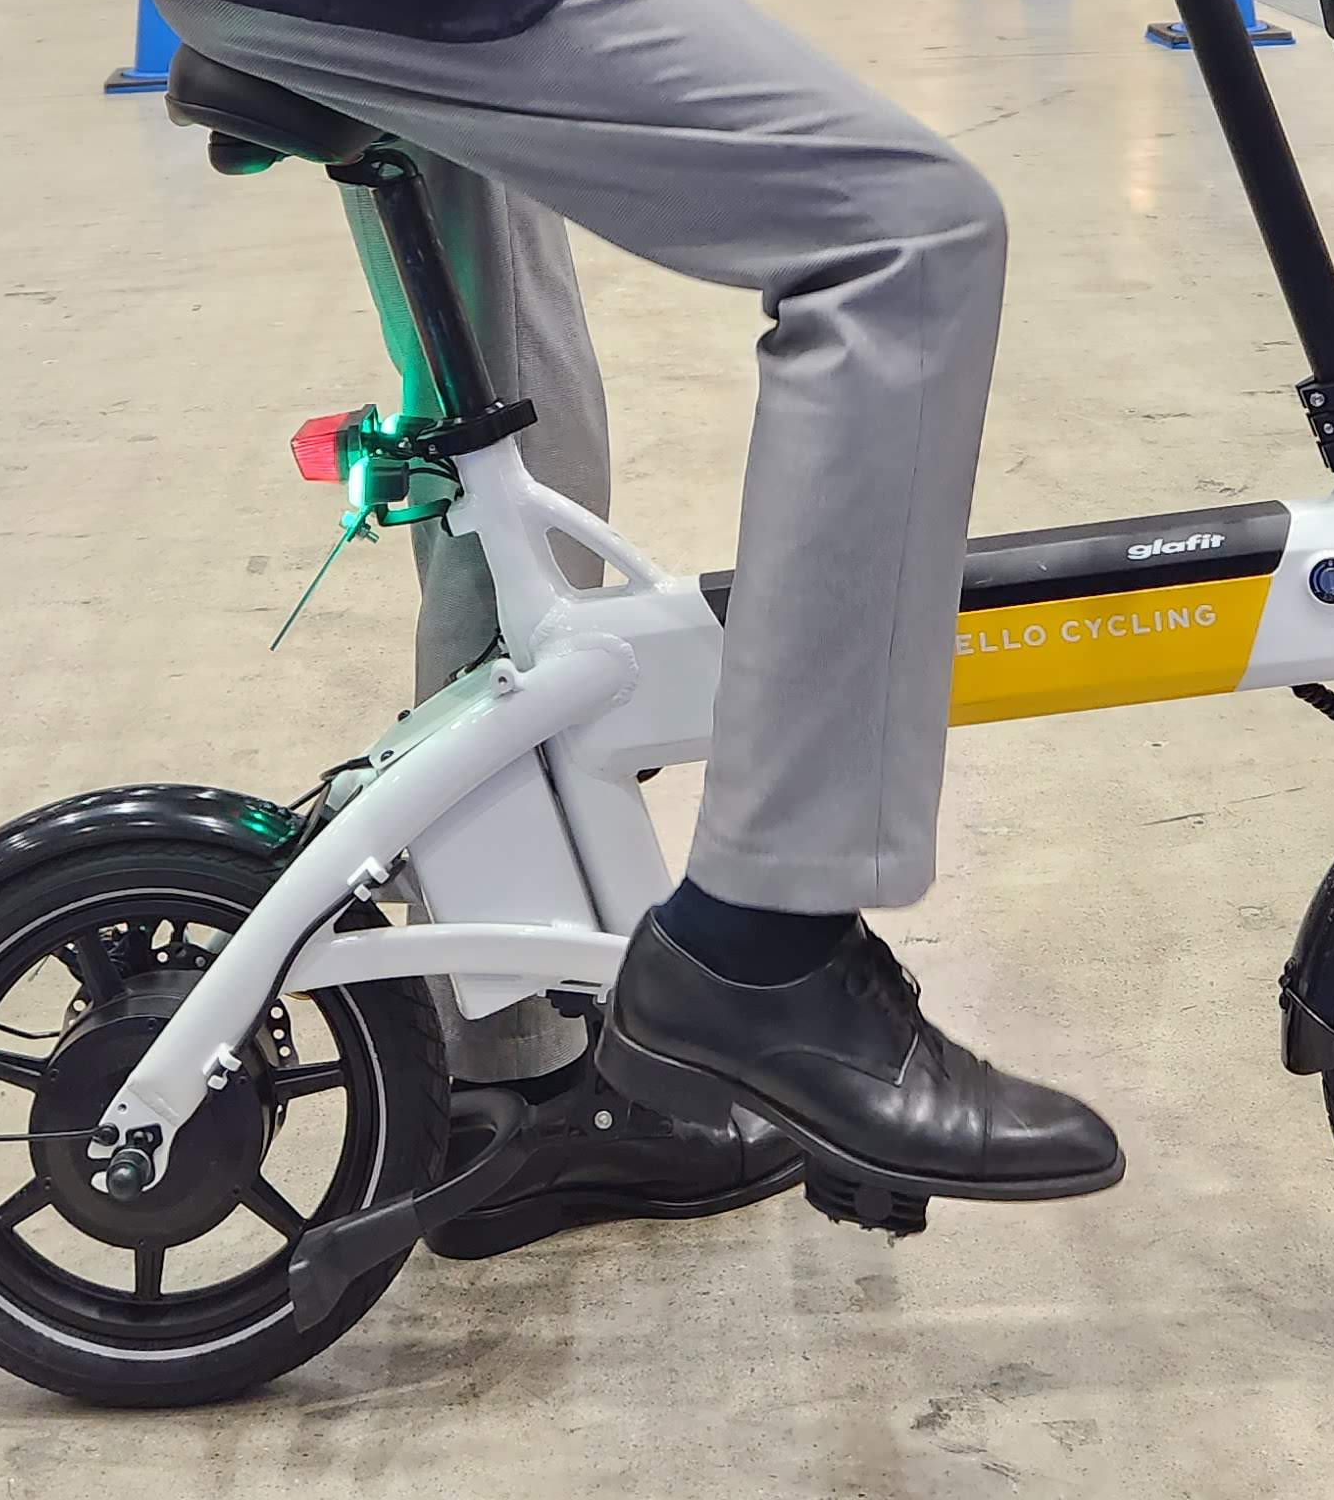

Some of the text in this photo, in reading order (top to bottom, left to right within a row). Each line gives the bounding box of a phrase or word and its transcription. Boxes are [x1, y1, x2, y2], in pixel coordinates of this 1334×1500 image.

[1127, 533, 1226, 560] glafit
[955, 604, 1216, 655] ELLO CYCLING
